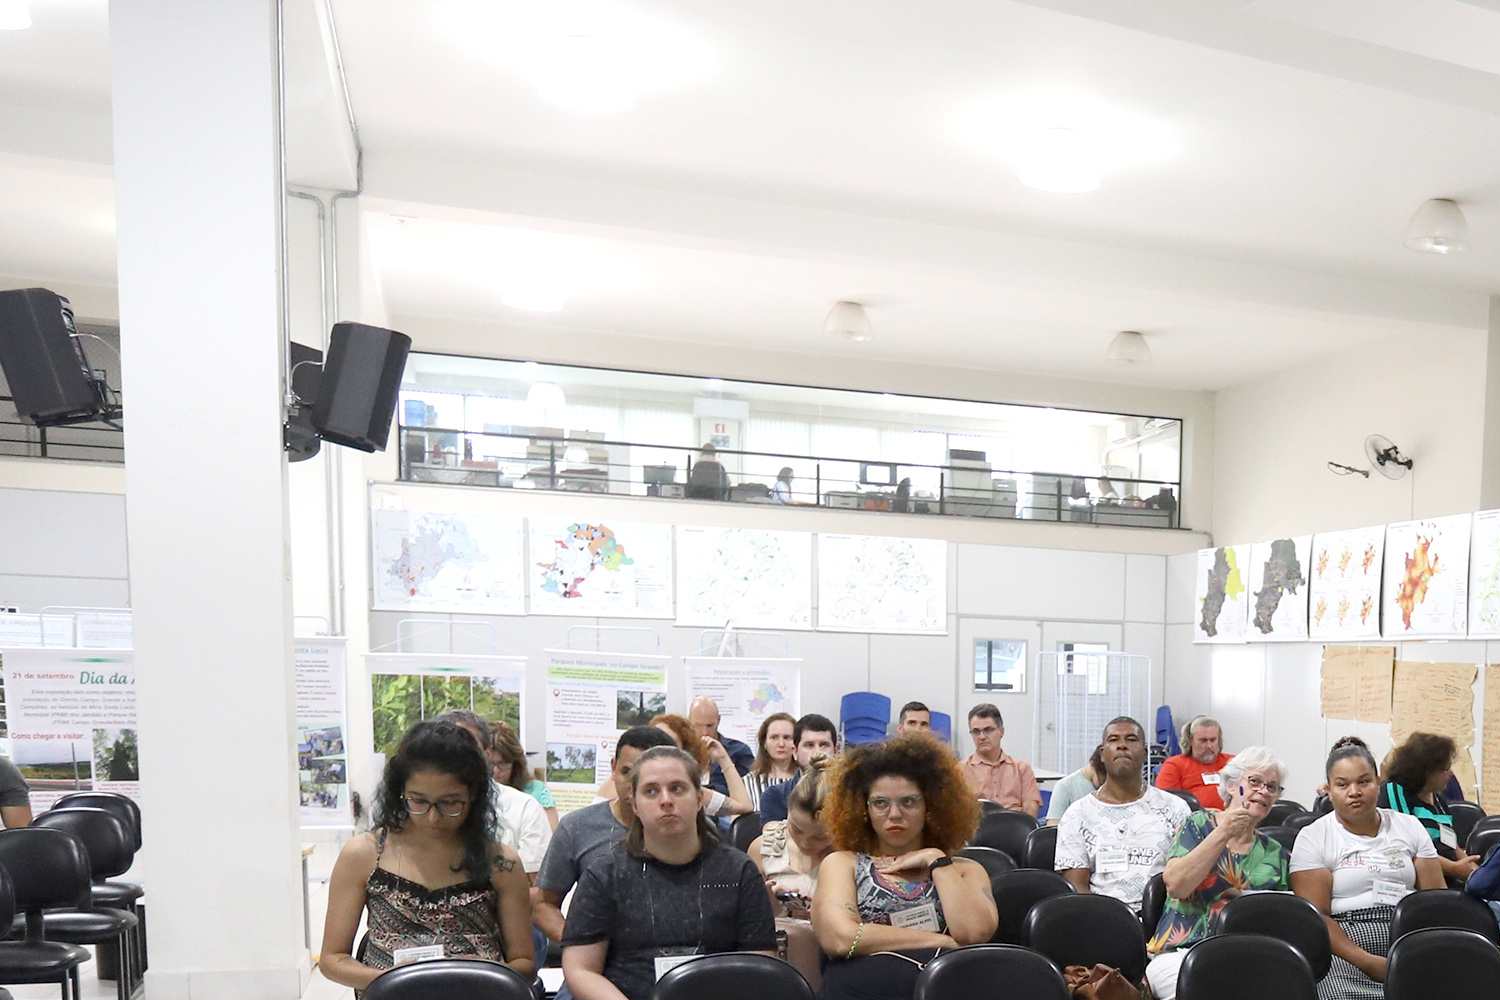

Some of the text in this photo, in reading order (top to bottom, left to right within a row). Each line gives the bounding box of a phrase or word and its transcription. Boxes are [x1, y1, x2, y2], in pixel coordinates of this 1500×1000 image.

[36, 672, 75, 680] setembro
[80, 671, 127, 685] Dia da
[11, 732, 31, 740] Como
[32, 733, 56, 742] chegar
